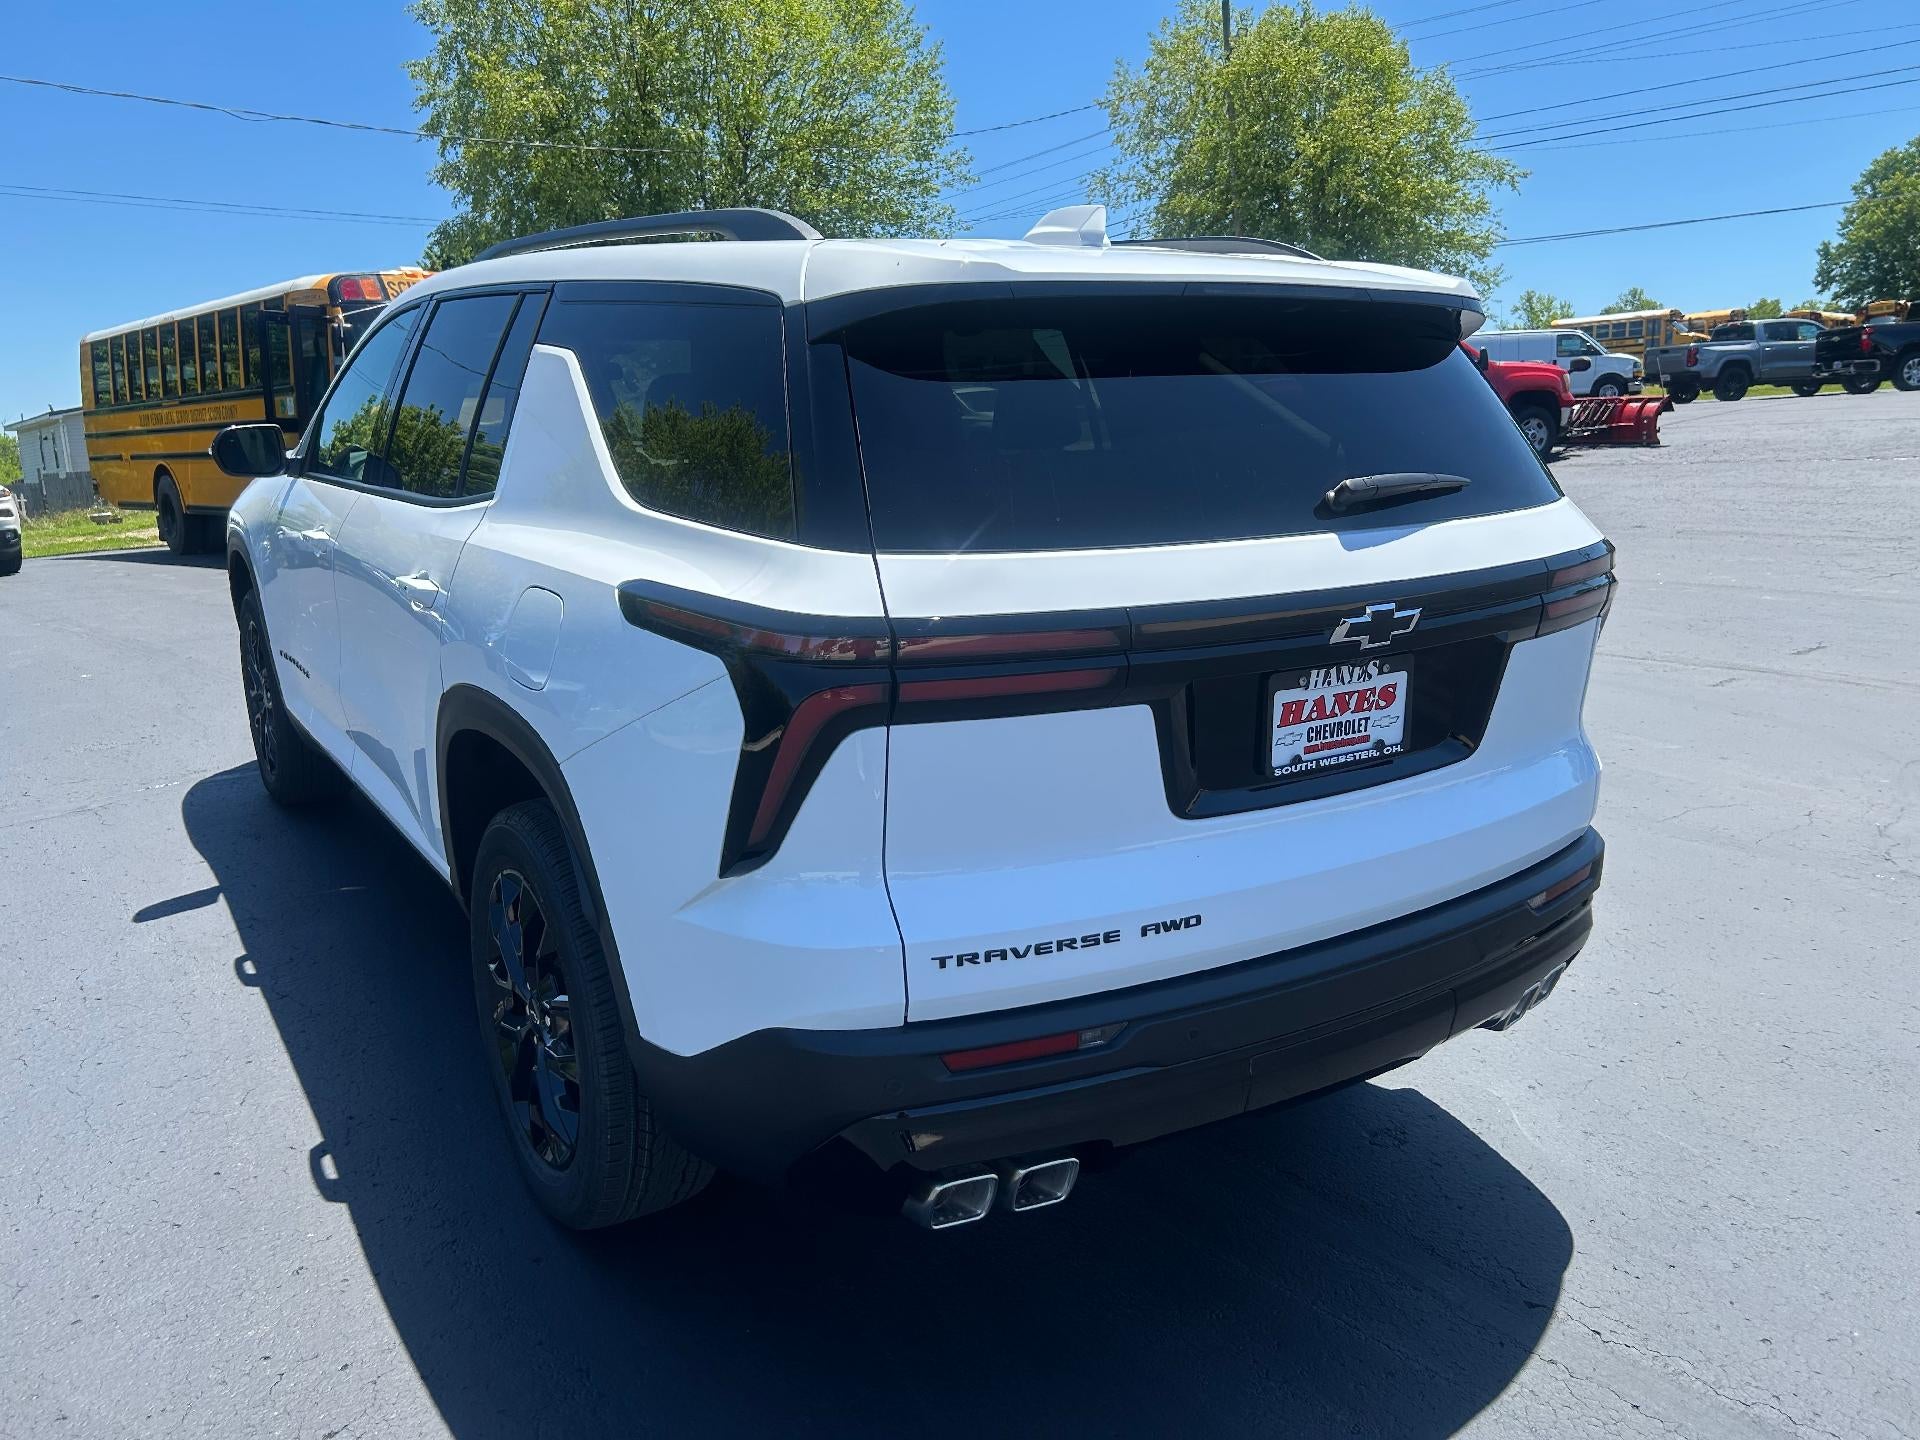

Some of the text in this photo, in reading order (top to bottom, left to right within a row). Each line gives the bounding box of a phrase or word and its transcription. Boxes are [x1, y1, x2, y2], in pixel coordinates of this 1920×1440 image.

[387, 280, 416, 298] SC
[1306, 659, 1379, 690] HANES
[1277, 682, 1397, 728] HANES
[1307, 717, 1370, 743] CHEVROLET
[1274, 760, 1316, 776] SOUTH
[1319, 750, 1380, 767] WEBSTER,
[931, 914, 1202, 969] TRAVERSE AWD
